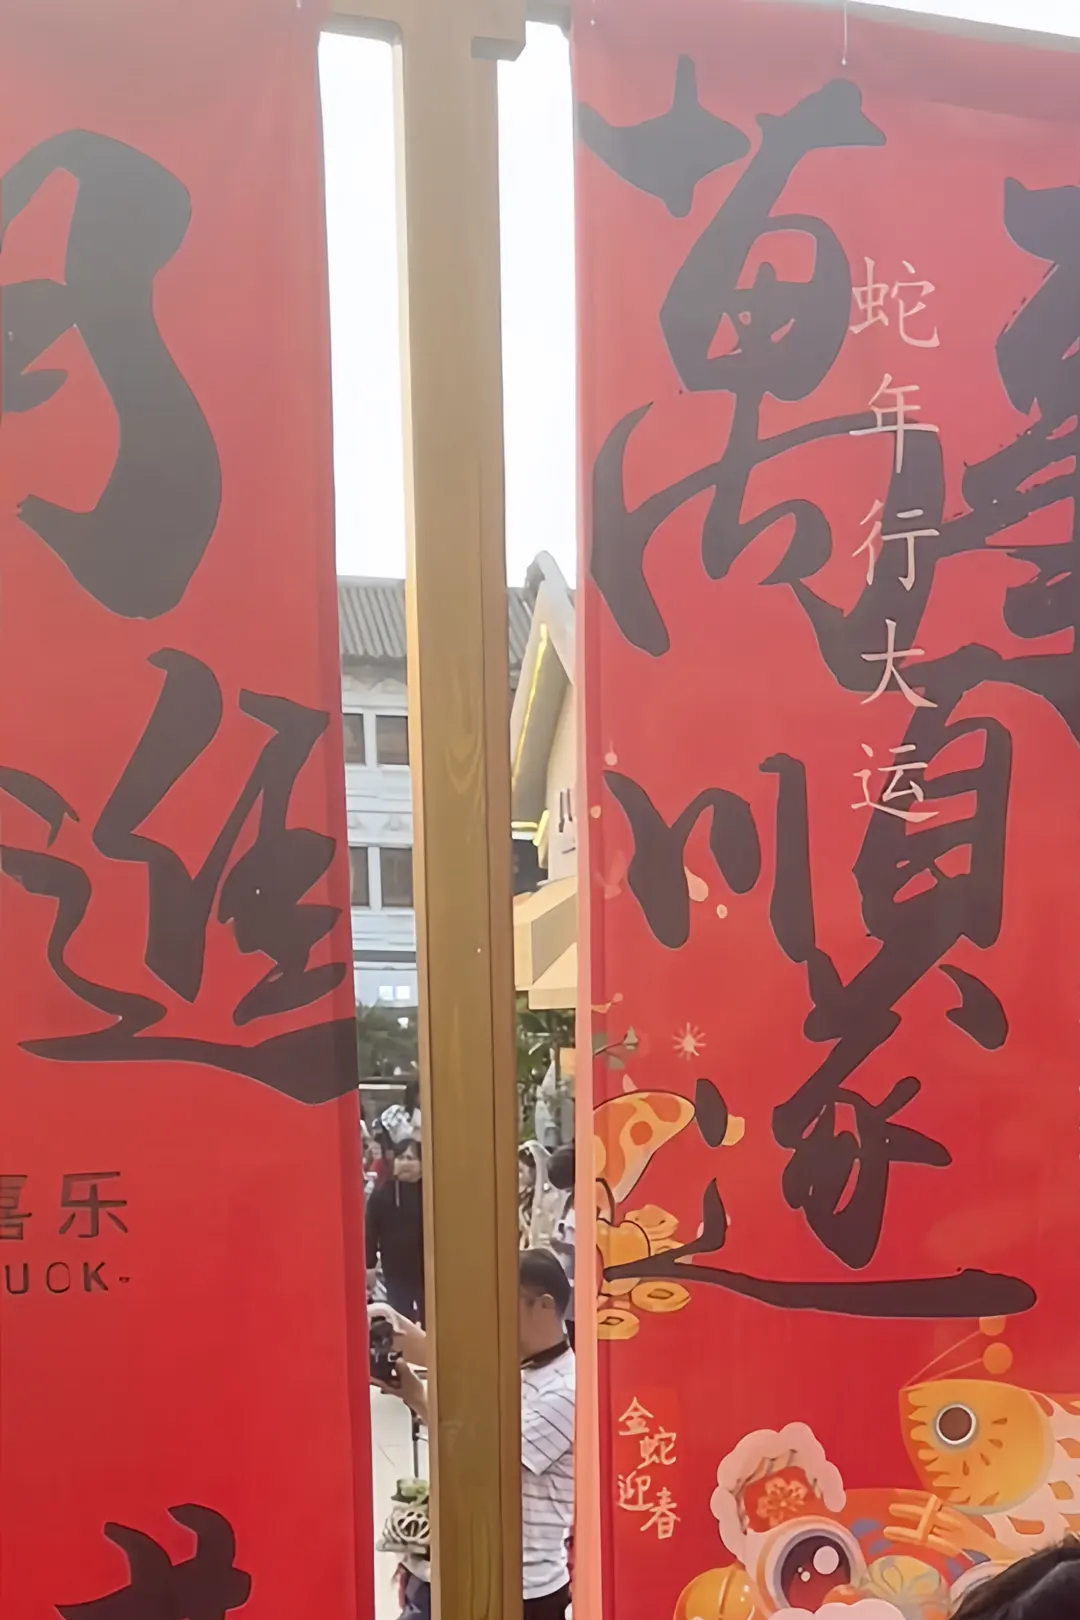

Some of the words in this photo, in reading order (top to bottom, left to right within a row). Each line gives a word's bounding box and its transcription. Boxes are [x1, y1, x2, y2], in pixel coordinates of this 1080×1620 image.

[850, 257, 940, 822] 蛇年行大运
[617, 1396, 681, 1540] 金蛇迎春
